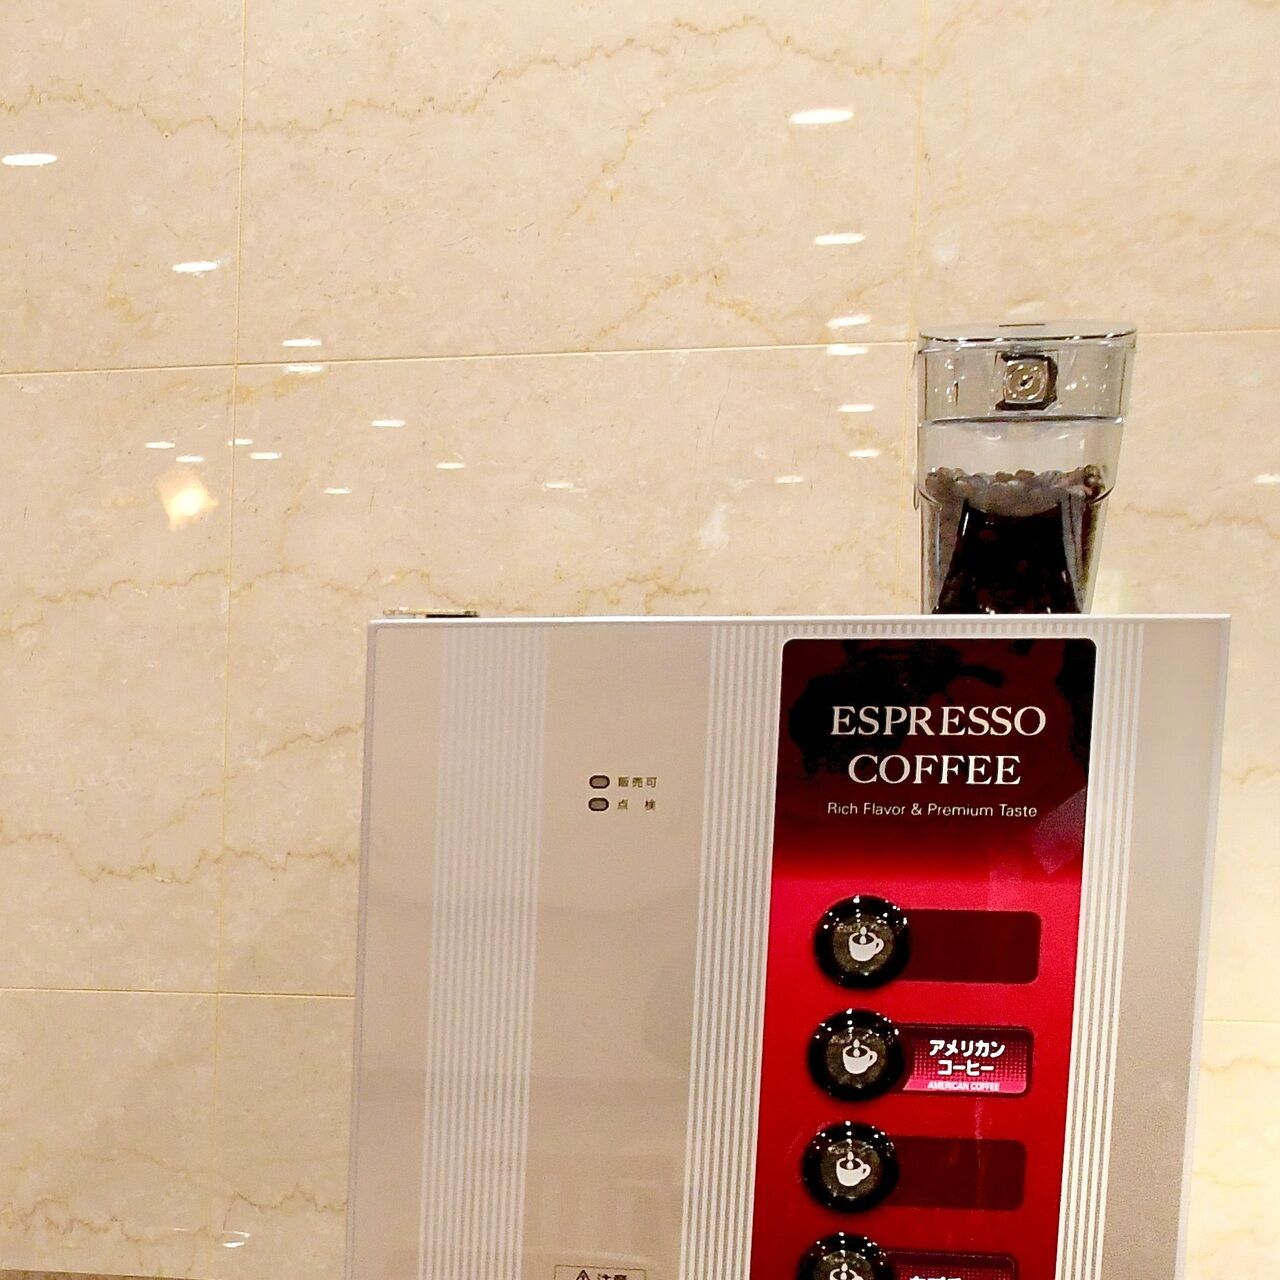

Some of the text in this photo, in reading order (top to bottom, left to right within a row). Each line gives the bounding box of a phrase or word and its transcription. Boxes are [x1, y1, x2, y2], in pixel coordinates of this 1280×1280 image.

[830, 705, 1047, 736] ESPRESSO
[848, 754, 1022, 785] COFFEE
[827, 801, 1038, 818] Rich Flavor & Premium Taste
[929, 1039, 1006, 1058] アメリカン
[937, 1059, 994, 1076] コーヒー
[928, 1081, 1000, 1092] AMERICAN COFFEE
